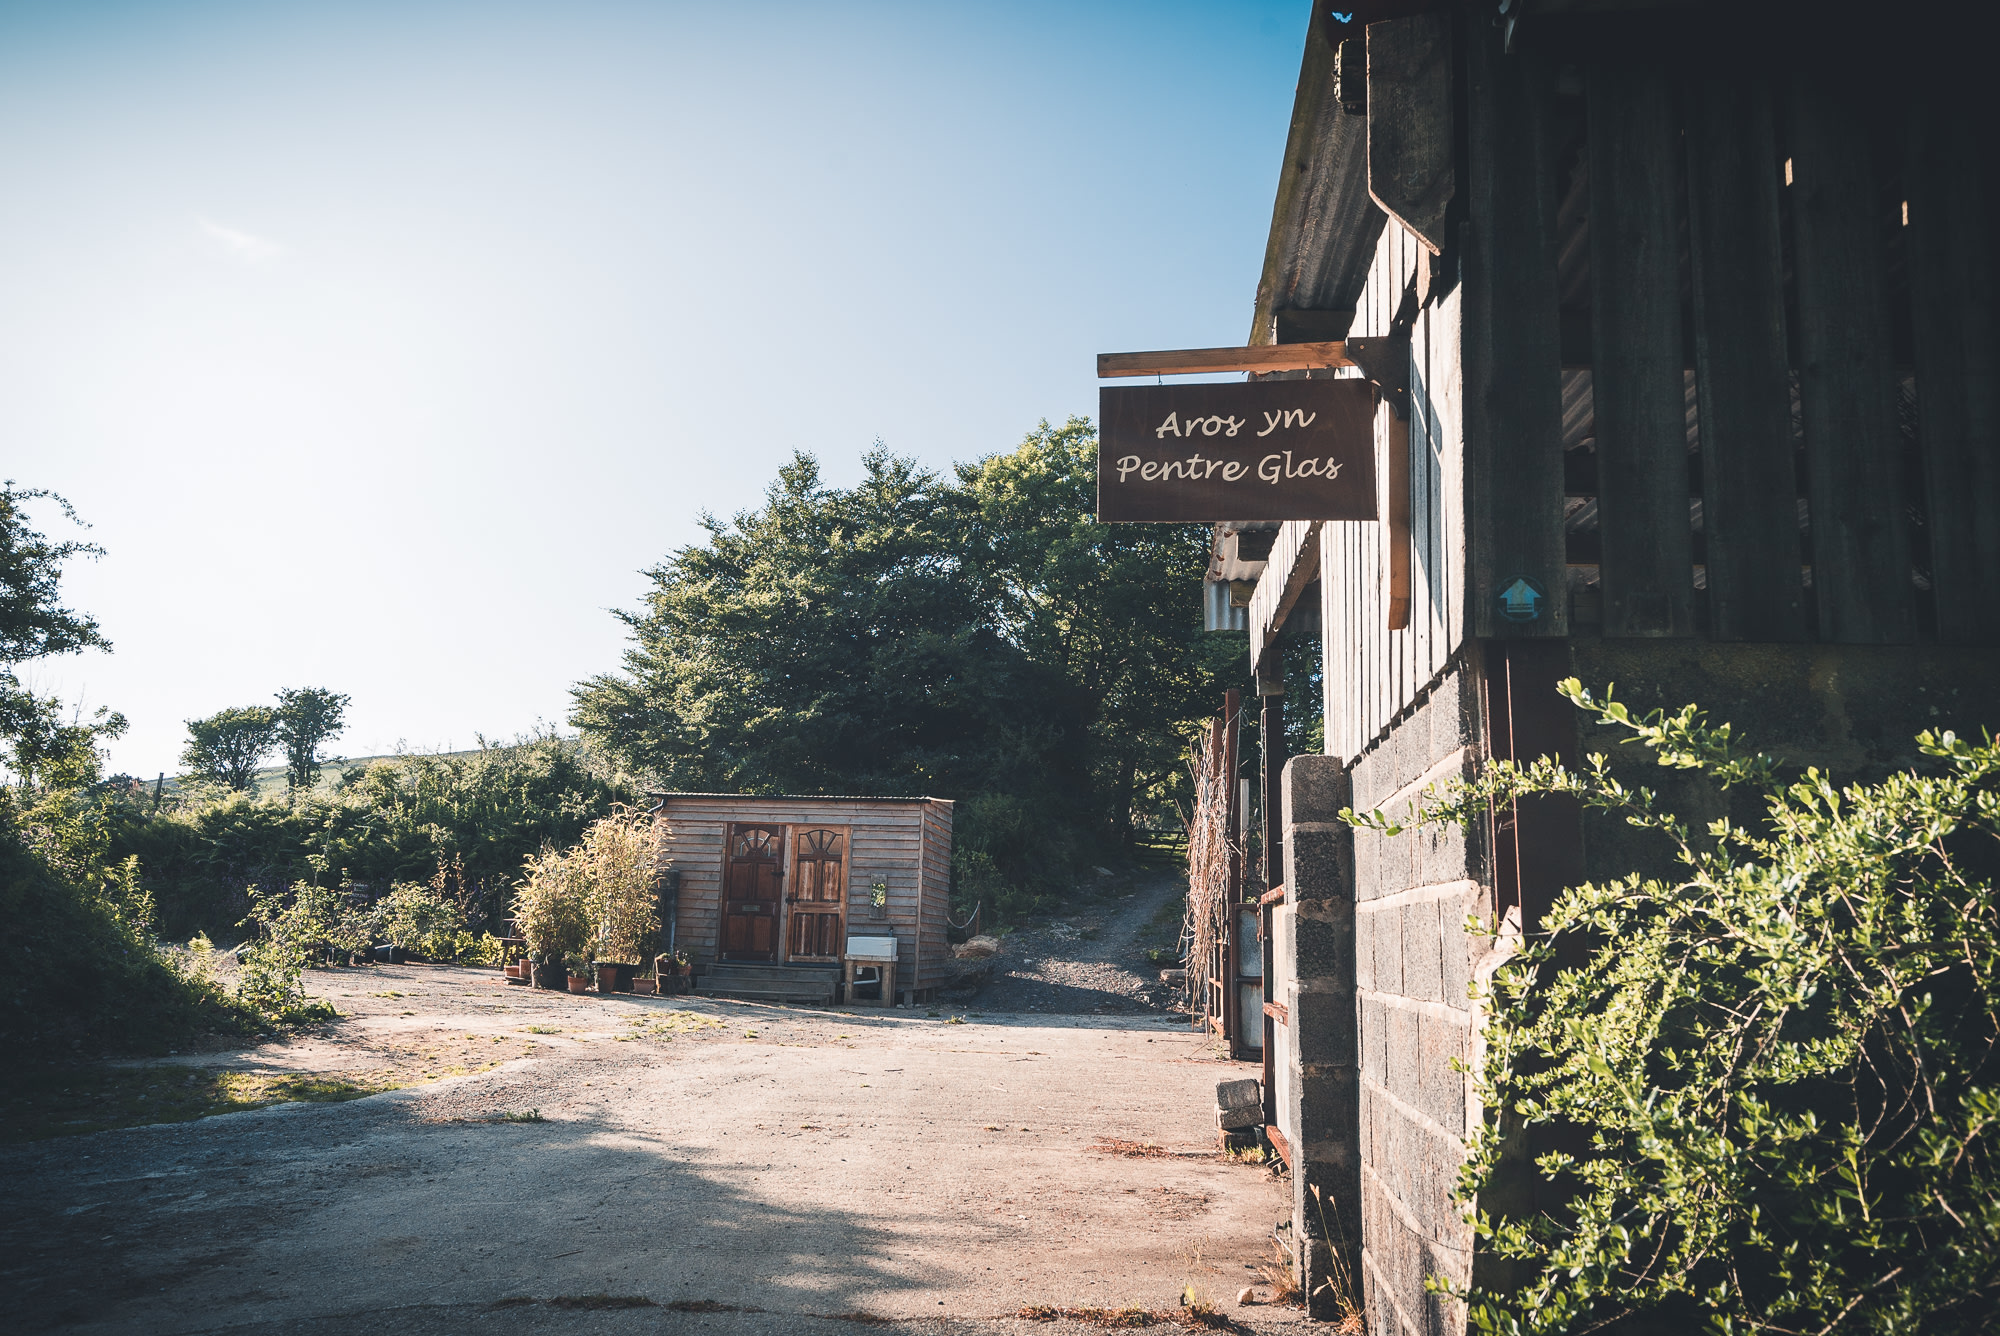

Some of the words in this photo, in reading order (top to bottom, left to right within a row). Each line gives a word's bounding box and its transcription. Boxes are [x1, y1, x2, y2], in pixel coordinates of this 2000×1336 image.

[1155, 411, 1246, 439] Aros
[1256, 407, 1317, 438] yn
[1116, 453, 1249, 483] Pentre
[1257, 450, 1344, 485] Glas
